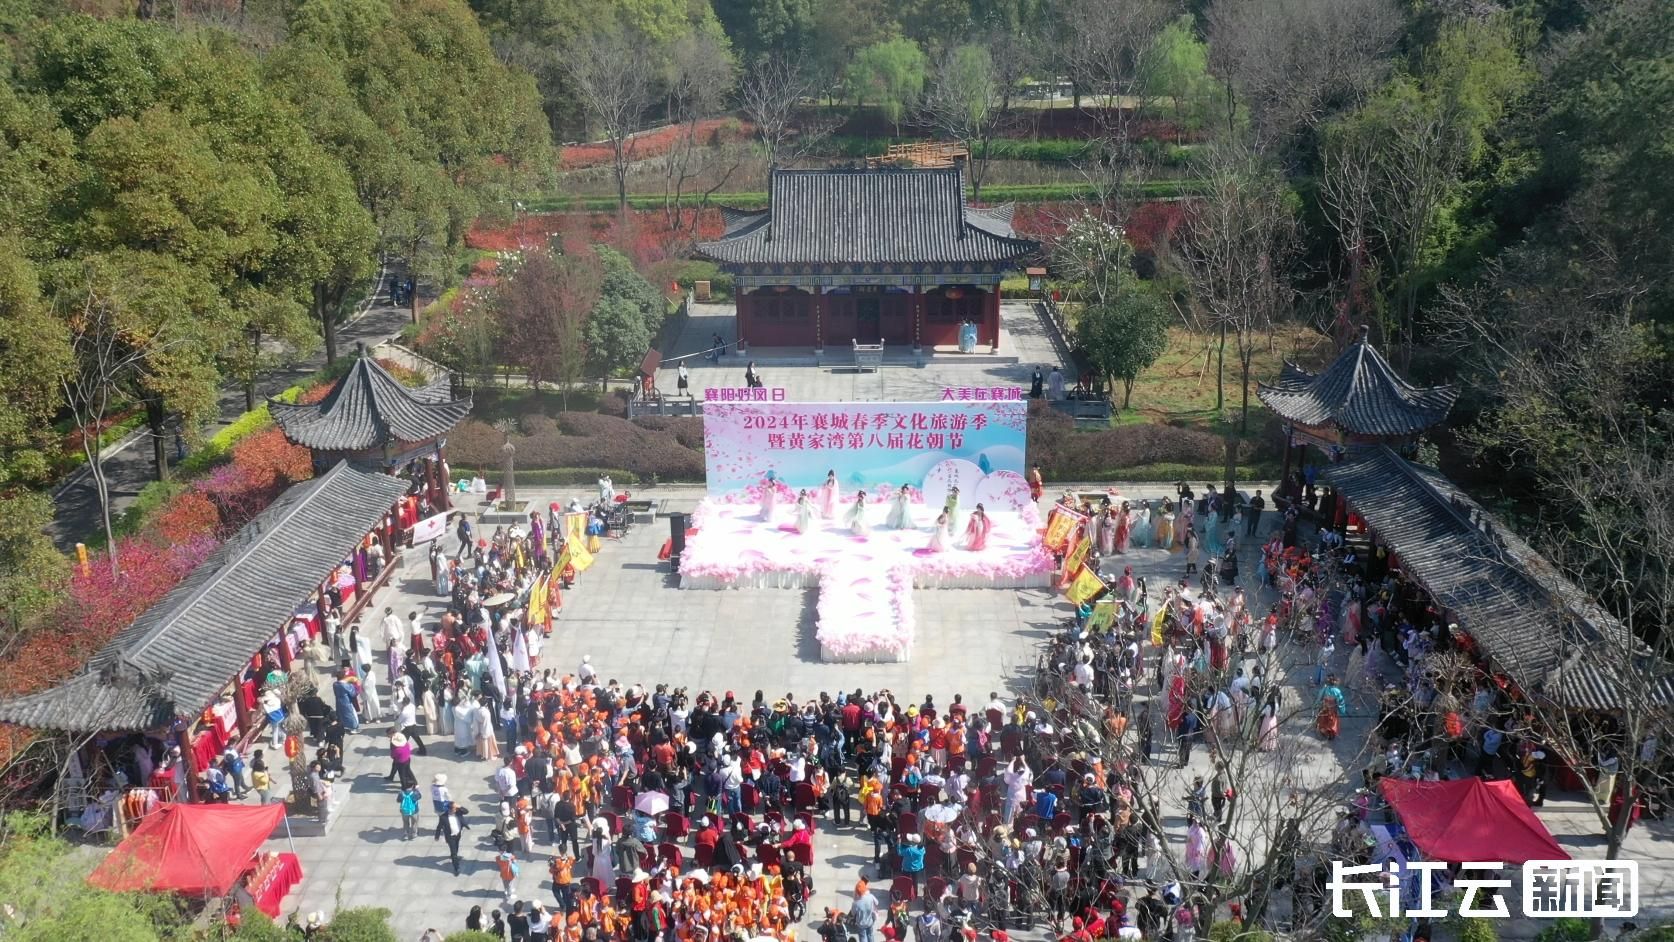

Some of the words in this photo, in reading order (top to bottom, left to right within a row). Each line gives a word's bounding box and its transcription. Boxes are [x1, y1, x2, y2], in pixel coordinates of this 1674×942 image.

[704, 388, 785, 401] 襄阳好风日
[942, 387, 1022, 401] 大美在襄城
[743, 413, 988, 430] 2024年襄城春季文化旅游季
[768, 433, 964, 449] 暨黄家湾第八届花朝节
